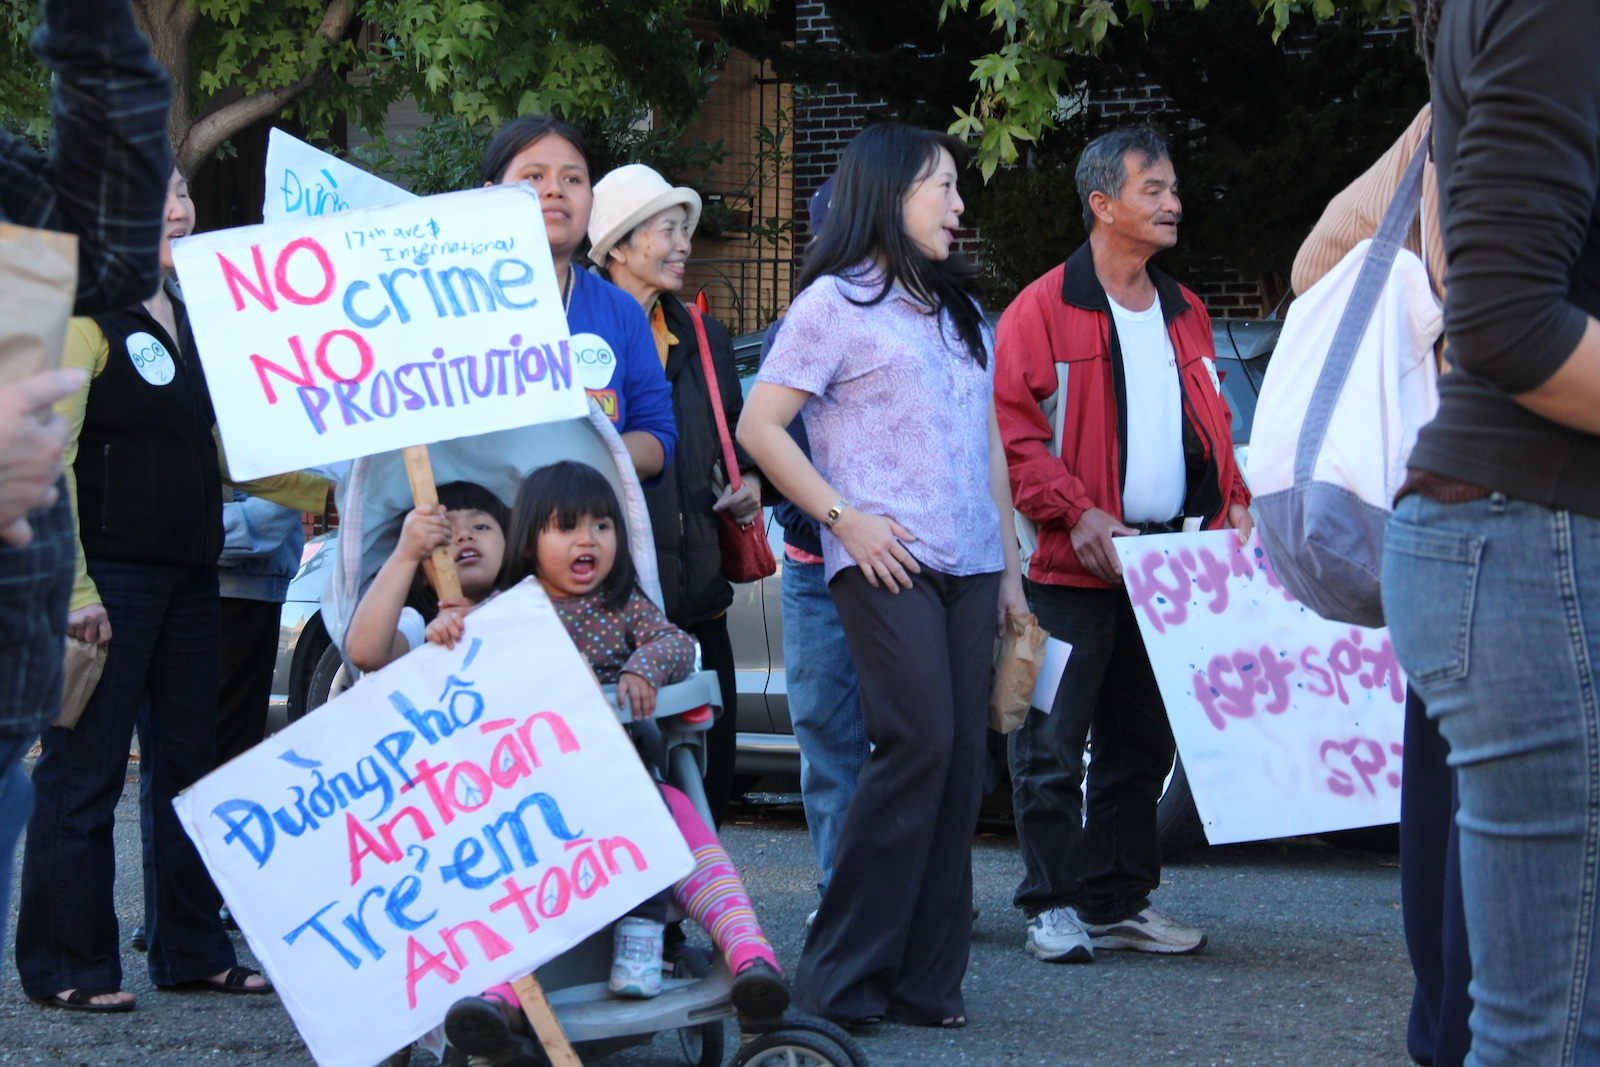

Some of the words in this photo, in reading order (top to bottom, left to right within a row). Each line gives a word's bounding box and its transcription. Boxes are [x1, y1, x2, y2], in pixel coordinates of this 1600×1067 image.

[345, 226, 387, 250] 17th
[393, 223, 426, 239] ave
[378, 235, 515, 262] International
[216, 237, 337, 313] NO
[342, 255, 538, 329] crime
[249, 329, 375, 405] NO
[345, 806, 436, 886] An
[405, 919, 514, 1009] An
